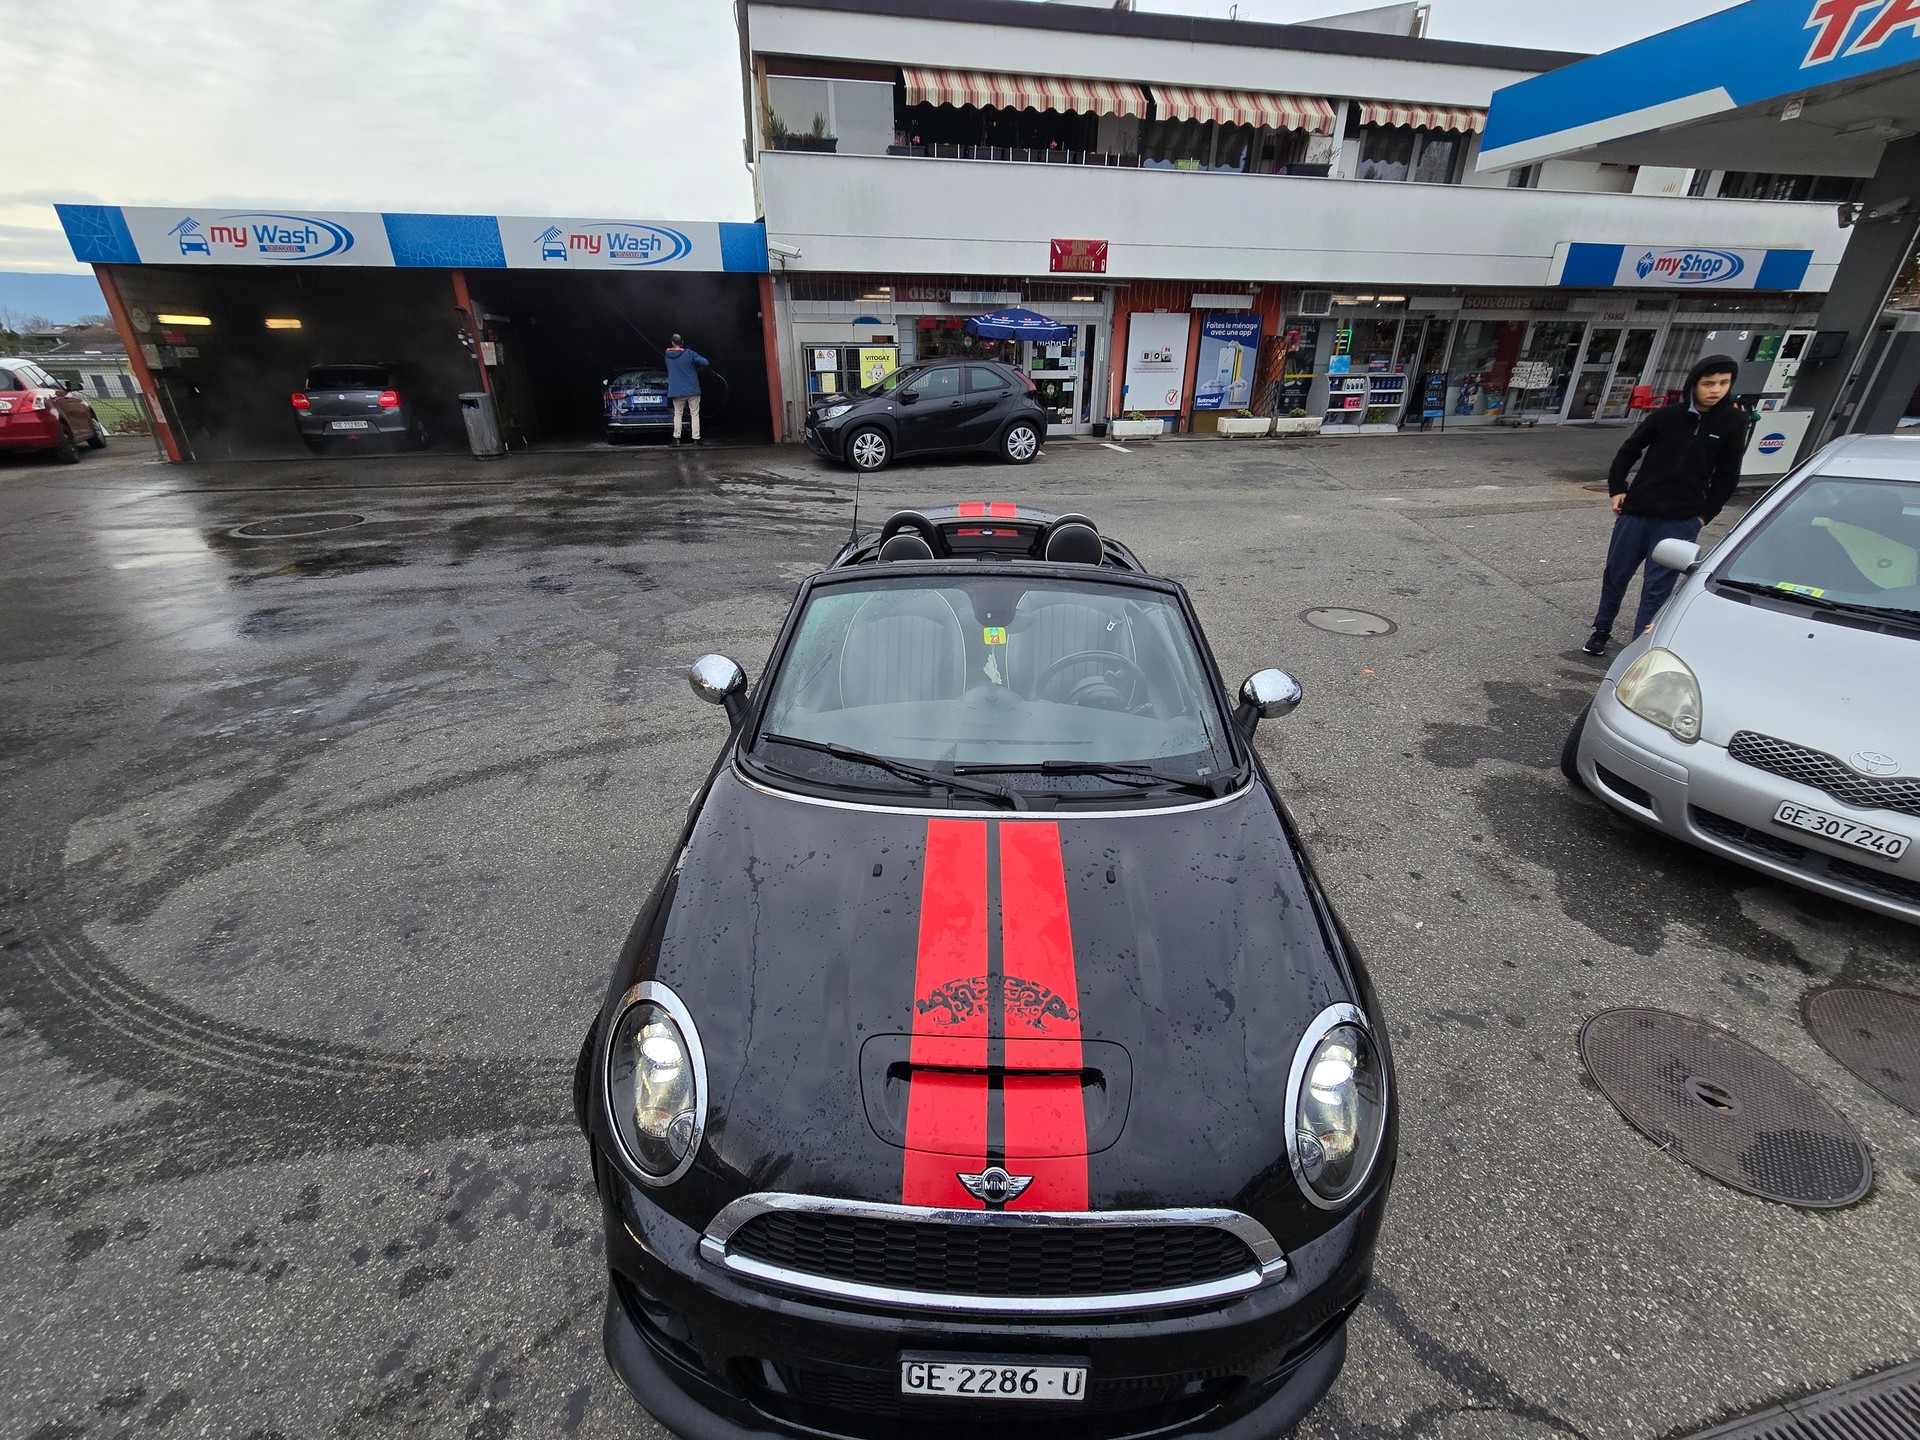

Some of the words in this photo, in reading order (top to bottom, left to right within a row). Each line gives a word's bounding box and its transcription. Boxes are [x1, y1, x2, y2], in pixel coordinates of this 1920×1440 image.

[210, 226, 247, 248] my
[252, 225, 319, 245] Wash
[569, 234, 601, 255] my
[606, 232, 662, 251] Wash
[1206, 321, 1225, 329] Faites
[1231, 322, 1258, 330] ménage
[1706, 330, 1717, 341] 4
[1738, 330, 1749, 341] 3
[1781, 368, 1789, 377] 3
[984, 1180, 1007, 1191] MINI
